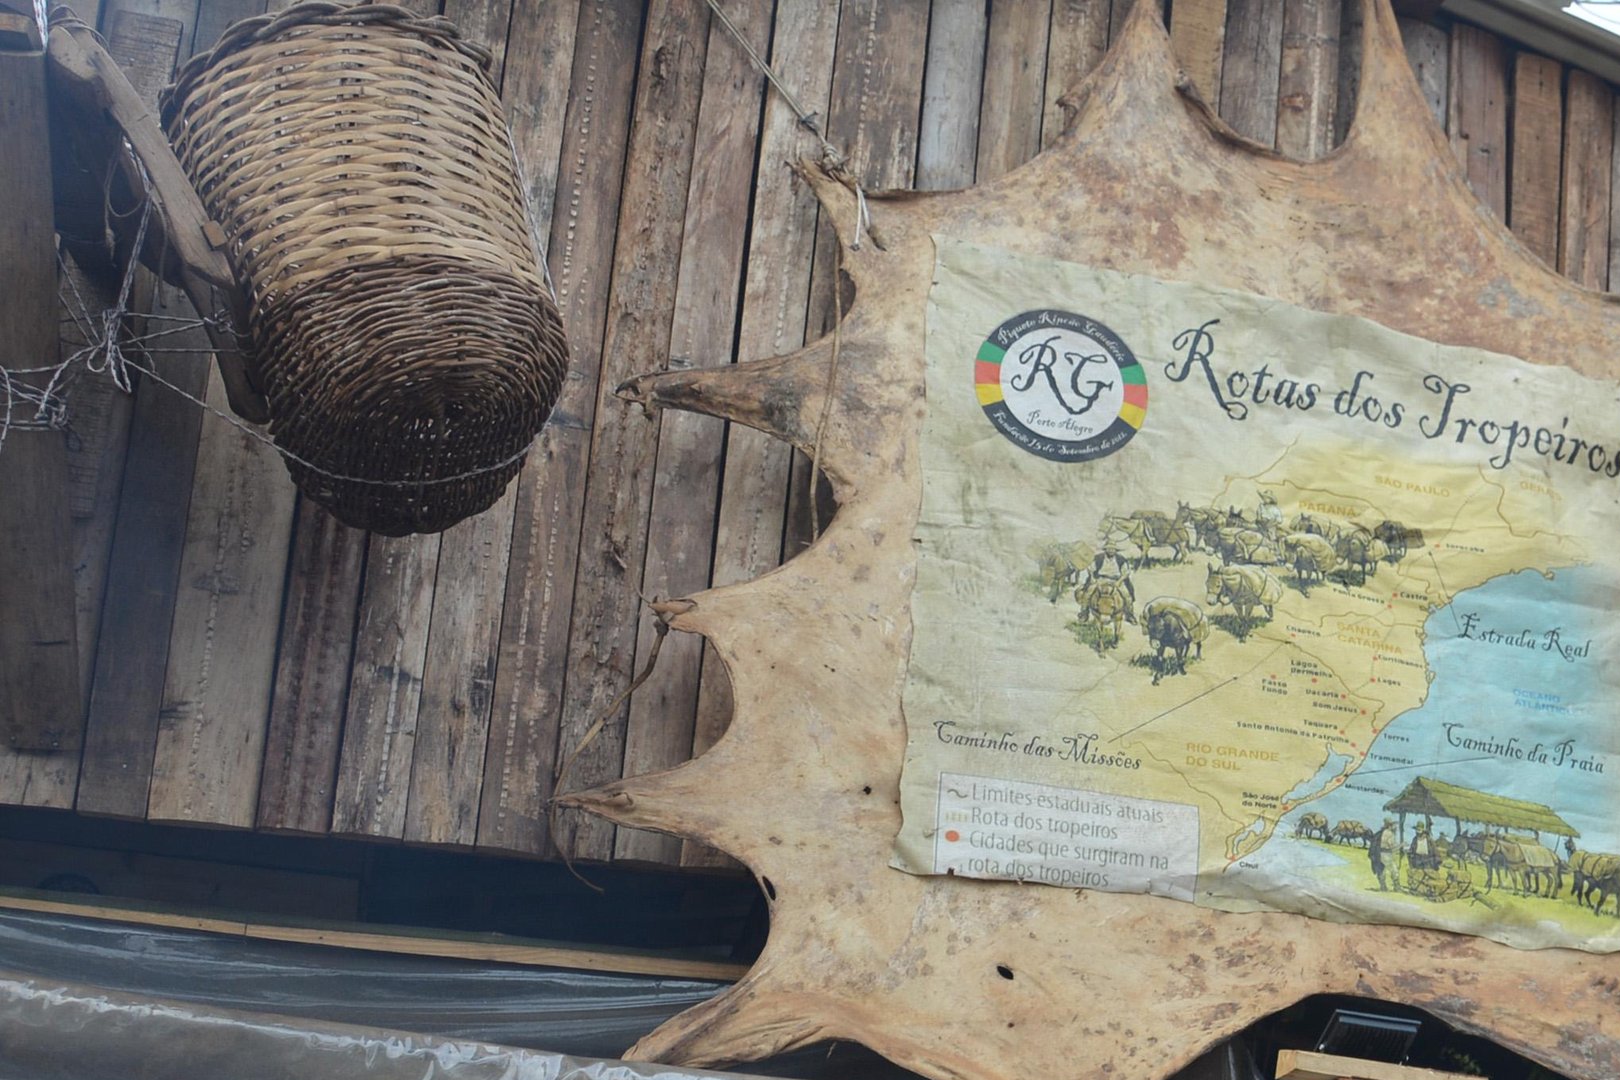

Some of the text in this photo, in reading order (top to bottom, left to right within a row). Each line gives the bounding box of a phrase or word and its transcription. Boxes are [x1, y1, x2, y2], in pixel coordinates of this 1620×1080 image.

[1011, 336, 1114, 415] RG
[1164, 318, 1321, 420] Rotas
[1333, 371, 1405, 428] dos
[1026, 409, 1056, 428] Porto
[1458, 612, 1592, 662] Estrada Real
[933, 720, 1142, 770] Caminho das Missões
[1186, 742, 1280, 762] RIO GRANDE
[1186, 755, 1241, 771] DO SUL
[1442, 722, 1605, 774] Caminho da Praia
[972, 784, 1164, 823] Limites estaduais atuais
[971, 807, 1118, 840] Rota dos tropeiros
[969, 831, 1169, 870] Cidades que surgiram na
[968, 860, 1109, 888] rota dos tropeiros
